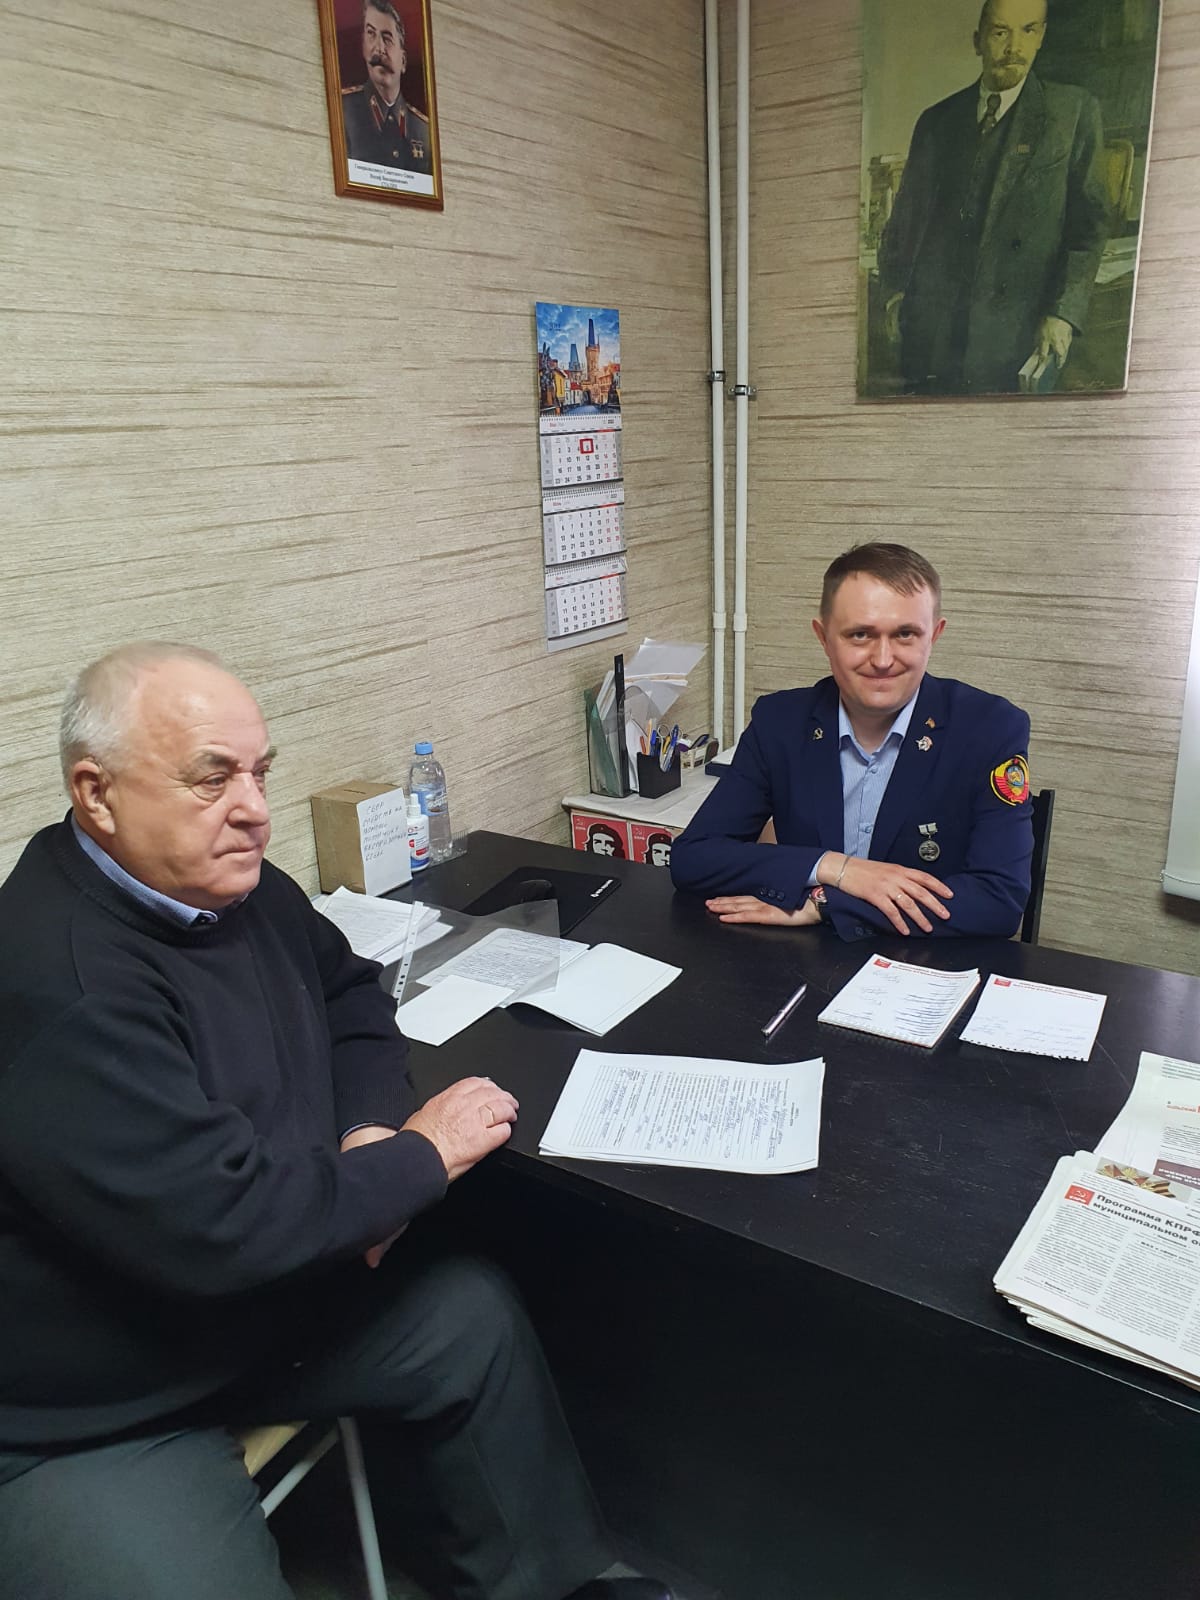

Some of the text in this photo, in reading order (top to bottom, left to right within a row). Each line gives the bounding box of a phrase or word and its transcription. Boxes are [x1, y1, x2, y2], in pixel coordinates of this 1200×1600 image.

[1092, 1202, 1188, 1241] муниципальном
[1096, 1194, 1162, 1223] Программа
[1165, 1219, 1200, 1237] КПРФ
